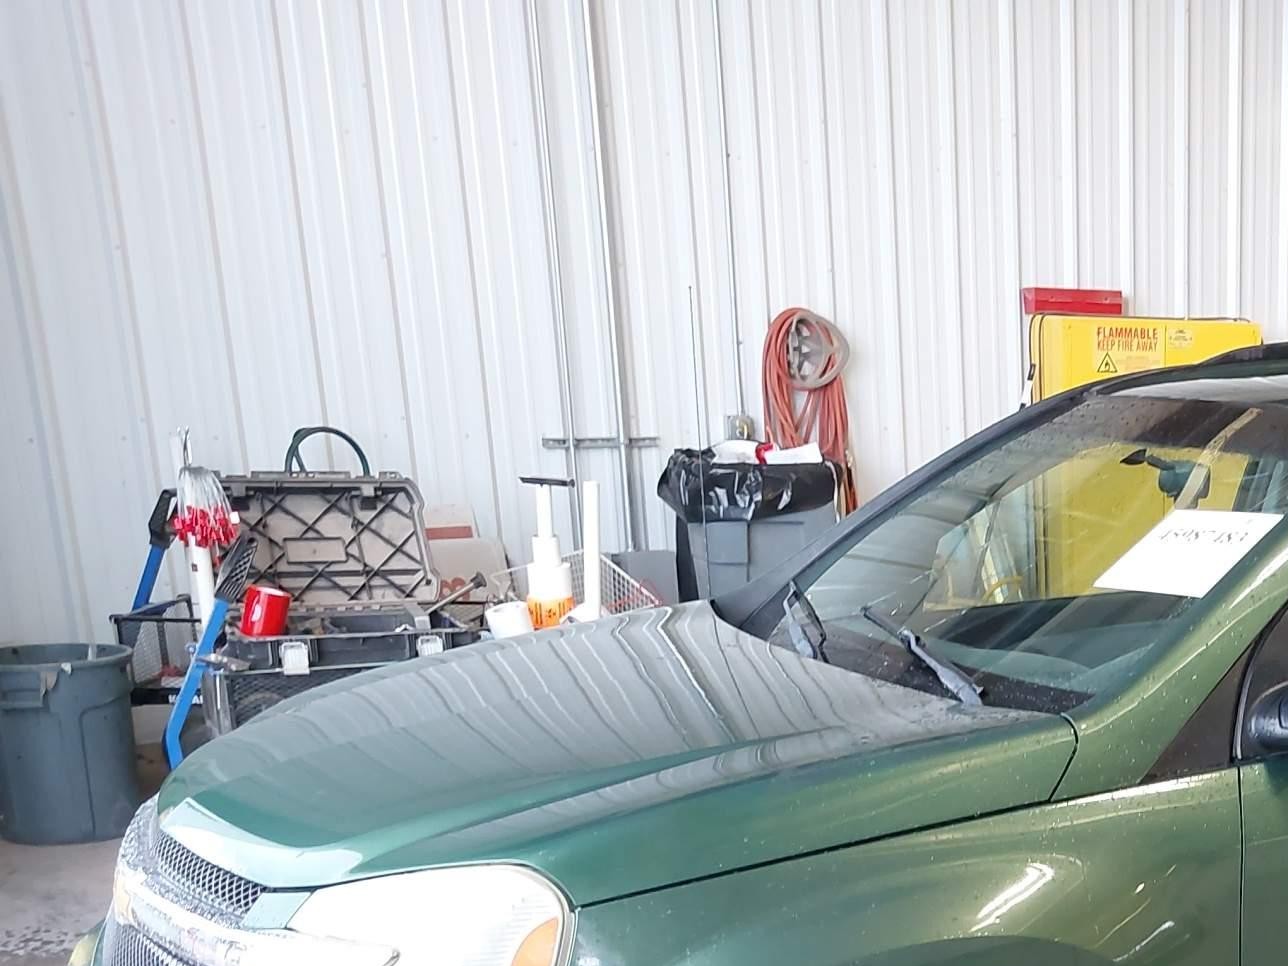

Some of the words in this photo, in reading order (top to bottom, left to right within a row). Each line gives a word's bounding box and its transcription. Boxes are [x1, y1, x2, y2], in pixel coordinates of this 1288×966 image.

[1097, 327, 1158, 340] FLAMMABLE
[1097, 340, 1115, 352] KEEP
[1118, 340, 1134, 352] FIRE
[1136, 340, 1158, 352] AWAY
